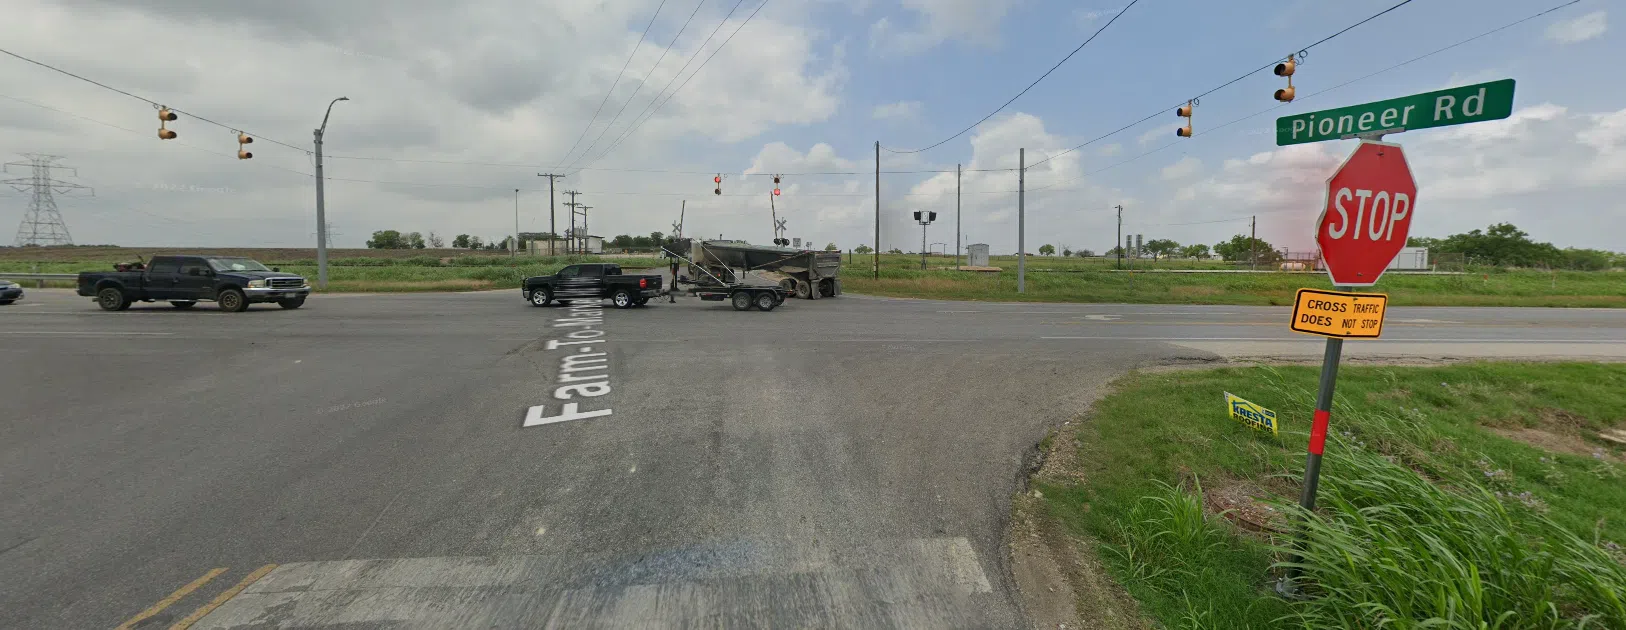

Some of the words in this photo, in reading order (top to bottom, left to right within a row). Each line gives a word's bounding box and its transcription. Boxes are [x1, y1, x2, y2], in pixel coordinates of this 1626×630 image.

[1292, 104, 1415, 140] Pioneer
[1433, 88, 1487, 121] Rd
[1328, 187, 1410, 241] STOP
[1307, 299, 1347, 313] CROSS
[1353, 303, 1379, 314] TRAFFIC
[1301, 314, 1332, 327] DOES
[1342, 319, 1357, 329] NOT
[1361, 319, 1378, 329] STOP
[1233, 404, 1273, 428] KRESTA
[1233, 413, 1273, 433] ROOFING
